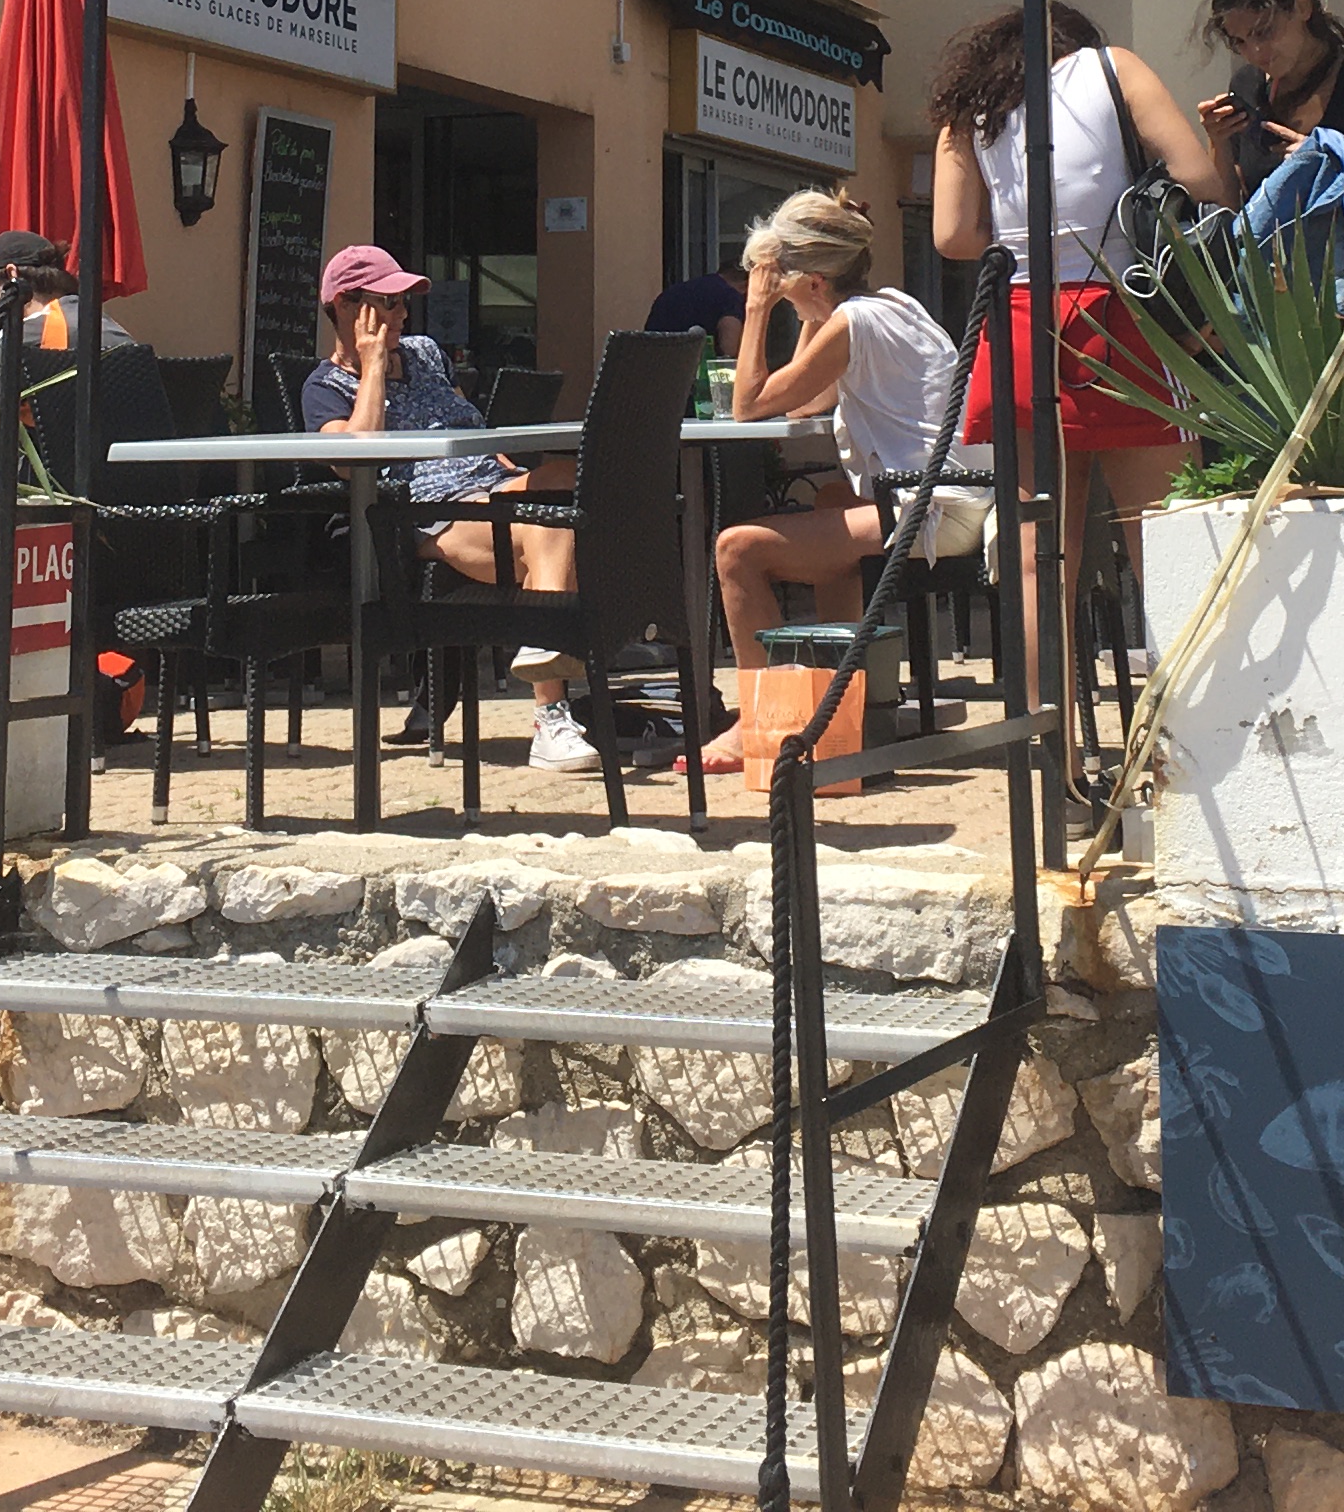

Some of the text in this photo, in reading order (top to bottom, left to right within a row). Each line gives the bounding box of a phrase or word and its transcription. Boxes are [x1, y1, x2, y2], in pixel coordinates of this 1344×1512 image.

[208, 0, 260, 27] GLACES
[267, 15, 283, 33] DE
[289, 21, 358, 54] MARSEILLE
[732, 1, 864, 70] Commodore
[702, 104, 801, 143] BRASSERIE GLACIER
[703, 55, 851, 138] LE COMMODORE
